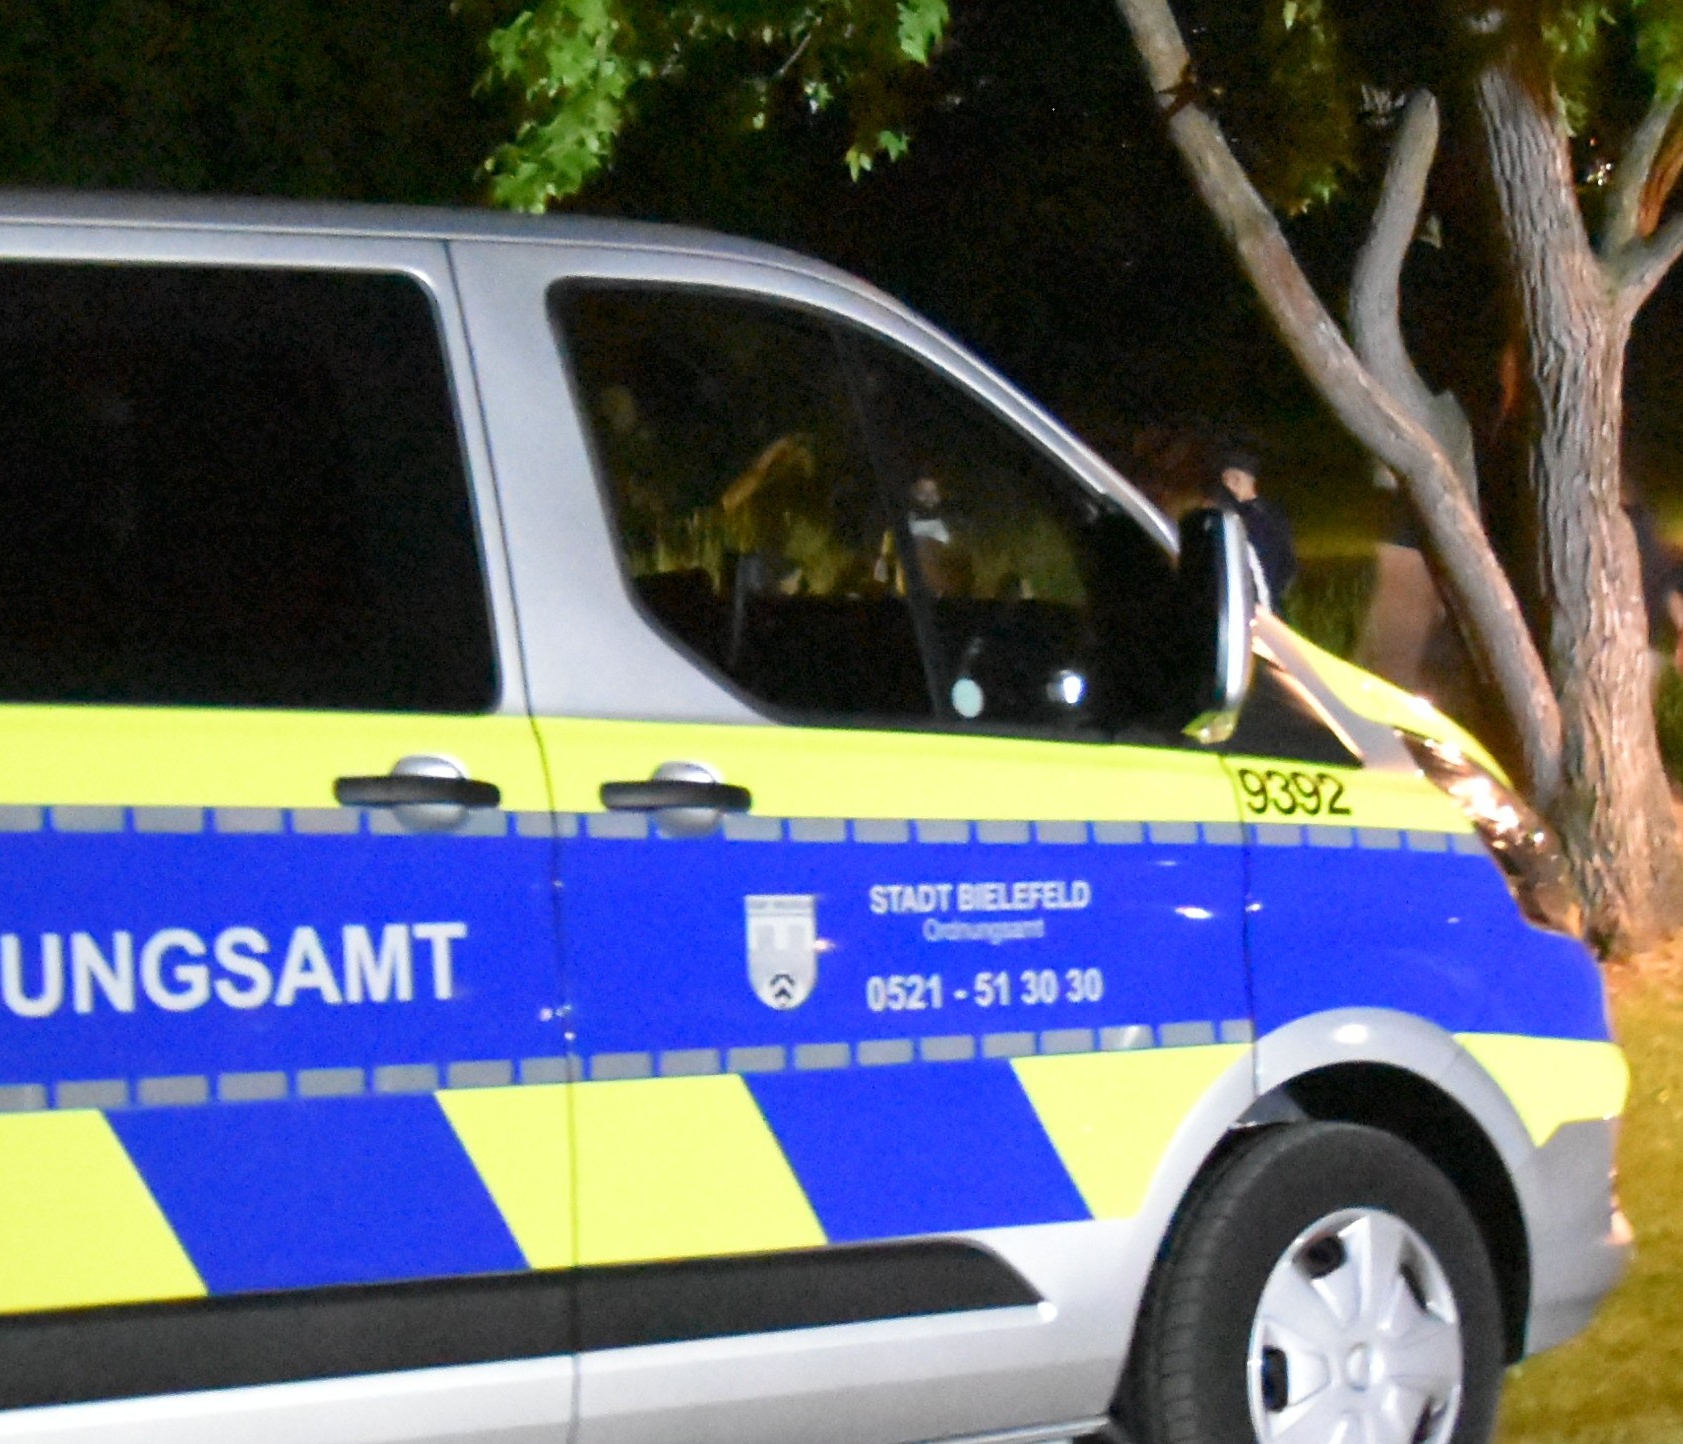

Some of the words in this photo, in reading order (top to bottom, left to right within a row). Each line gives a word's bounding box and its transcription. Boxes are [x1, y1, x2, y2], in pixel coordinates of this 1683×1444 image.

[1238, 768, 1353, 815] 9392
[868, 883, 952, 914] STADT
[957, 880, 1092, 911] BIELEFELD
[922, 918, 1045, 945] Ordnungsamt
[865, 974, 943, 1011] 0521
[974, 971, 1011, 1006] 51
[1020, 969, 1059, 1004] 30
[1065, 967, 1104, 1002] 30
